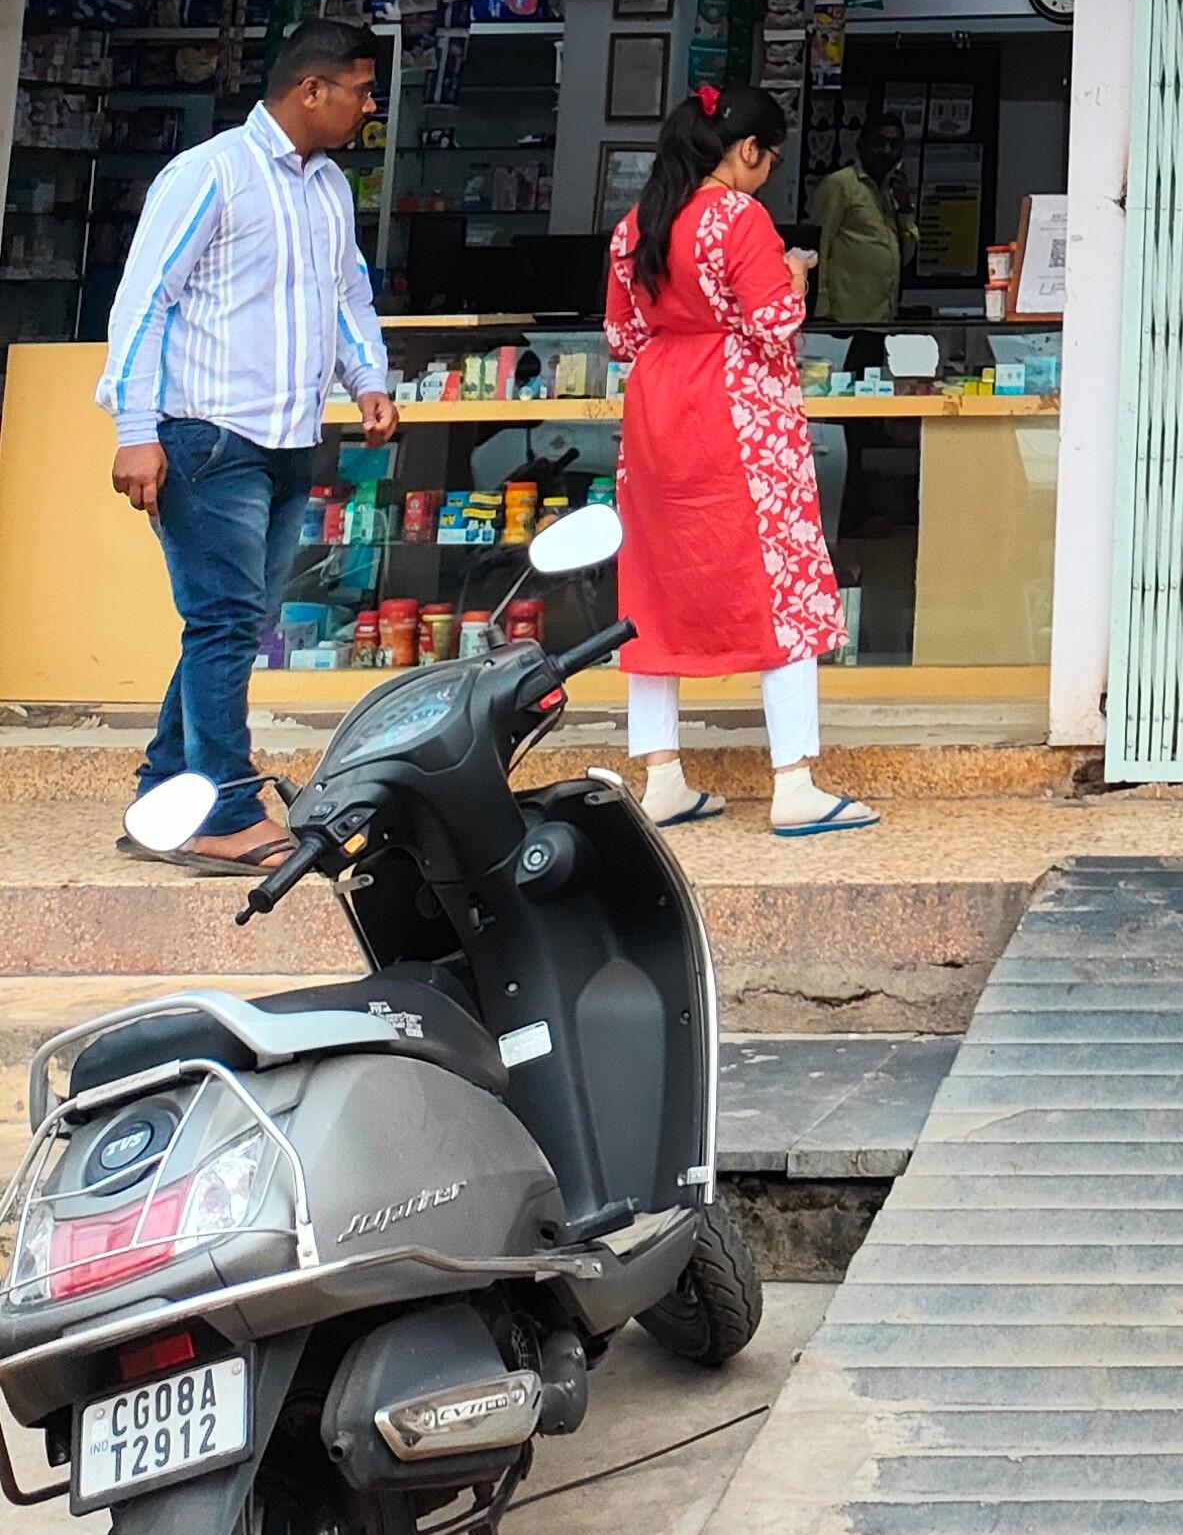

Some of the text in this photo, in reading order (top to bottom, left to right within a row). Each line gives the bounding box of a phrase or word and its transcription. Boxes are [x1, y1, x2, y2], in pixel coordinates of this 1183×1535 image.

[105, 1134, 145, 1159] TVS
[111, 1368, 217, 1437] CG08A
[89, 1440, 109, 1456] IND
[110, 1413, 217, 1482] T2912
